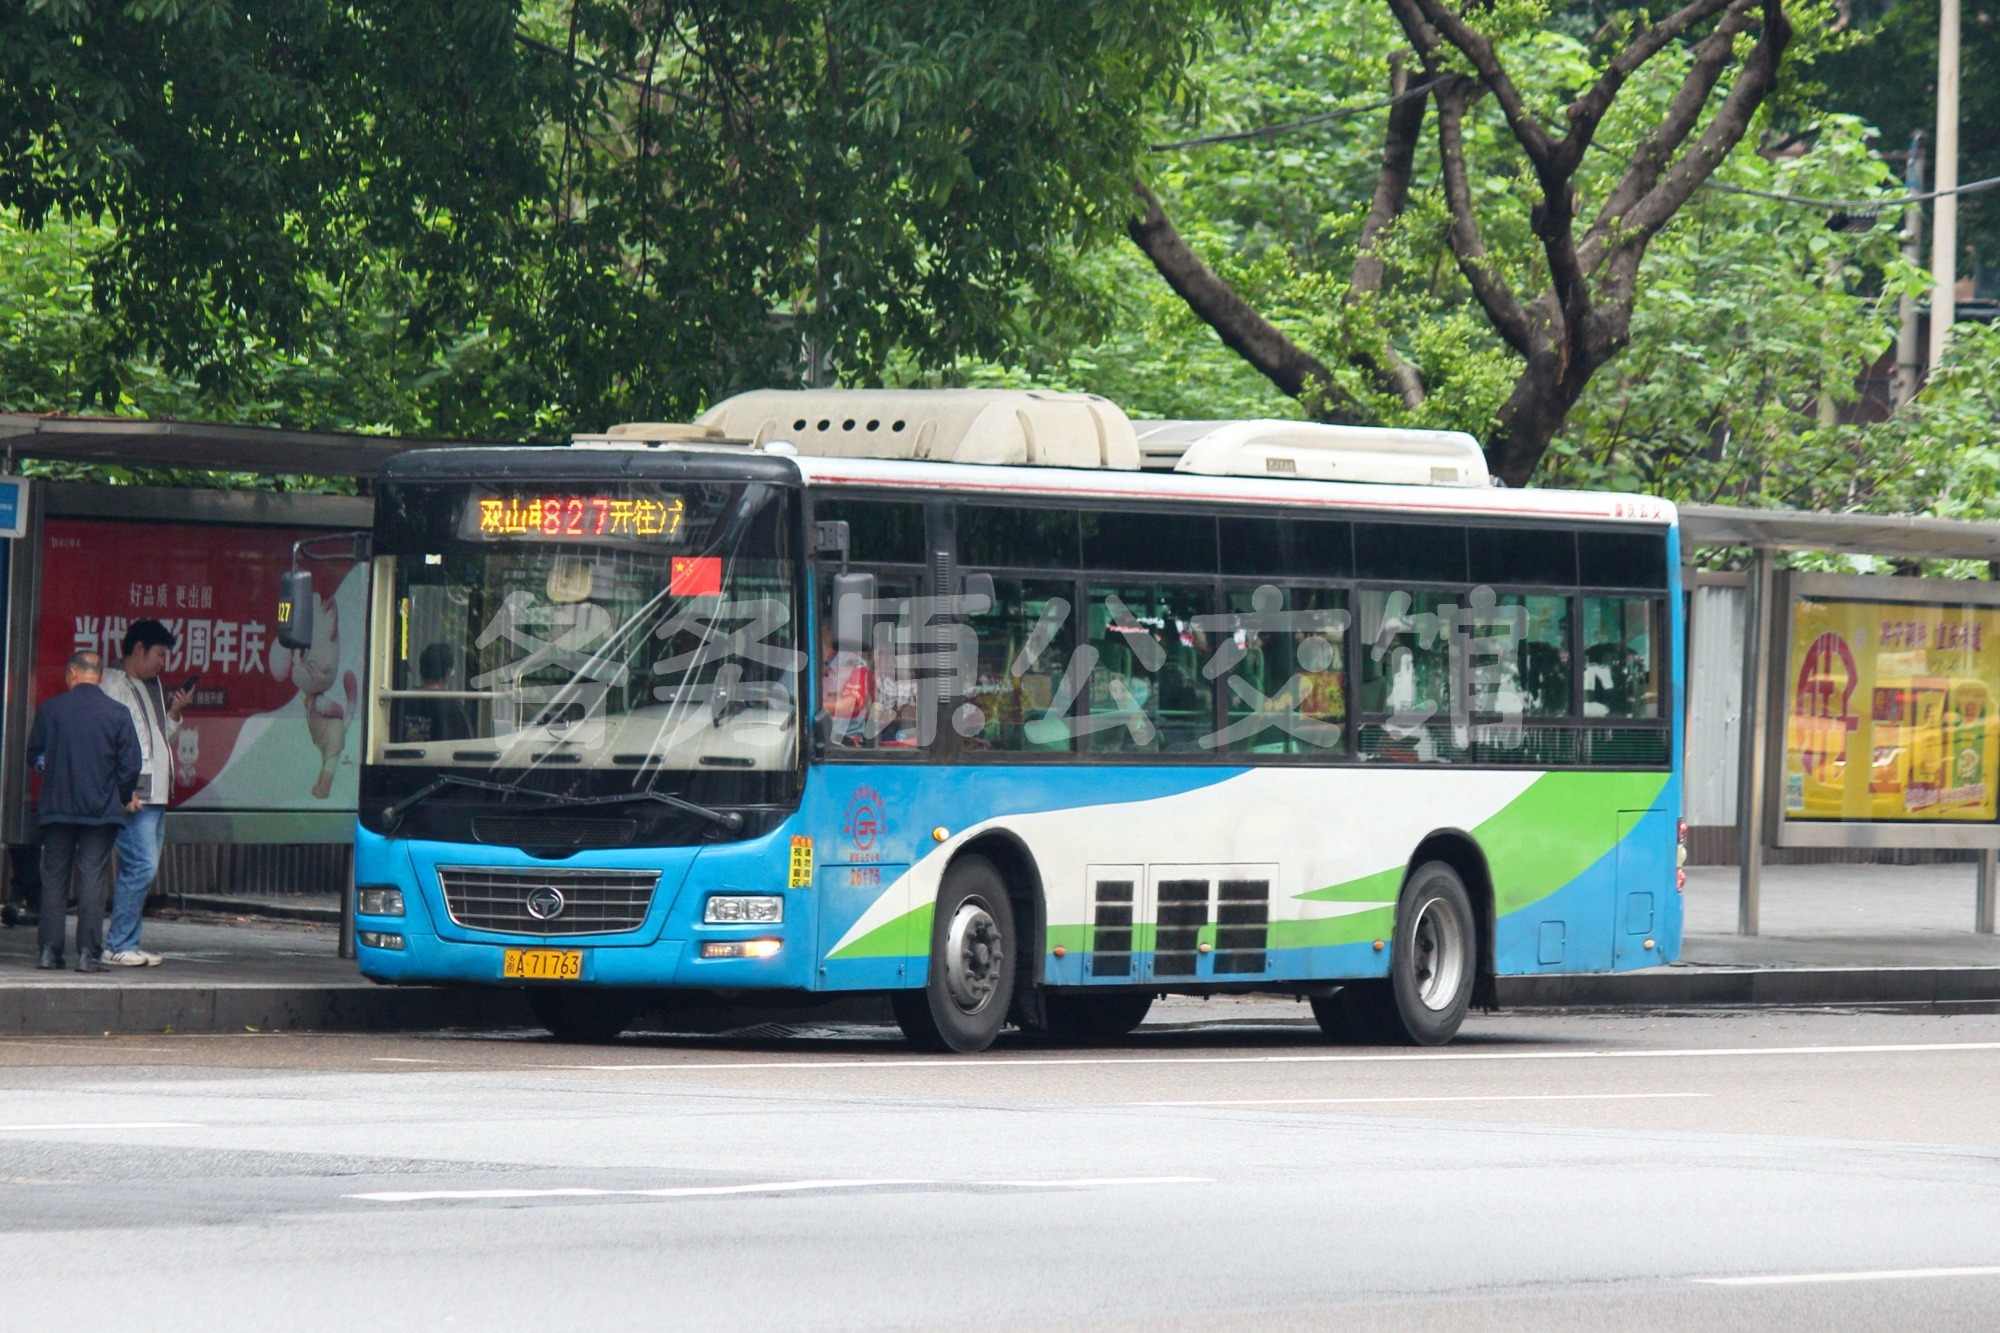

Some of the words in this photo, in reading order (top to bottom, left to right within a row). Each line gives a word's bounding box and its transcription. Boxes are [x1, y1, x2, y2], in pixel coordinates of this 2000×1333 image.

[543, 497, 608, 535] 827
[130, 583, 168, 608] 好品质
[74, 615, 267, 674] 当代形周年庆
